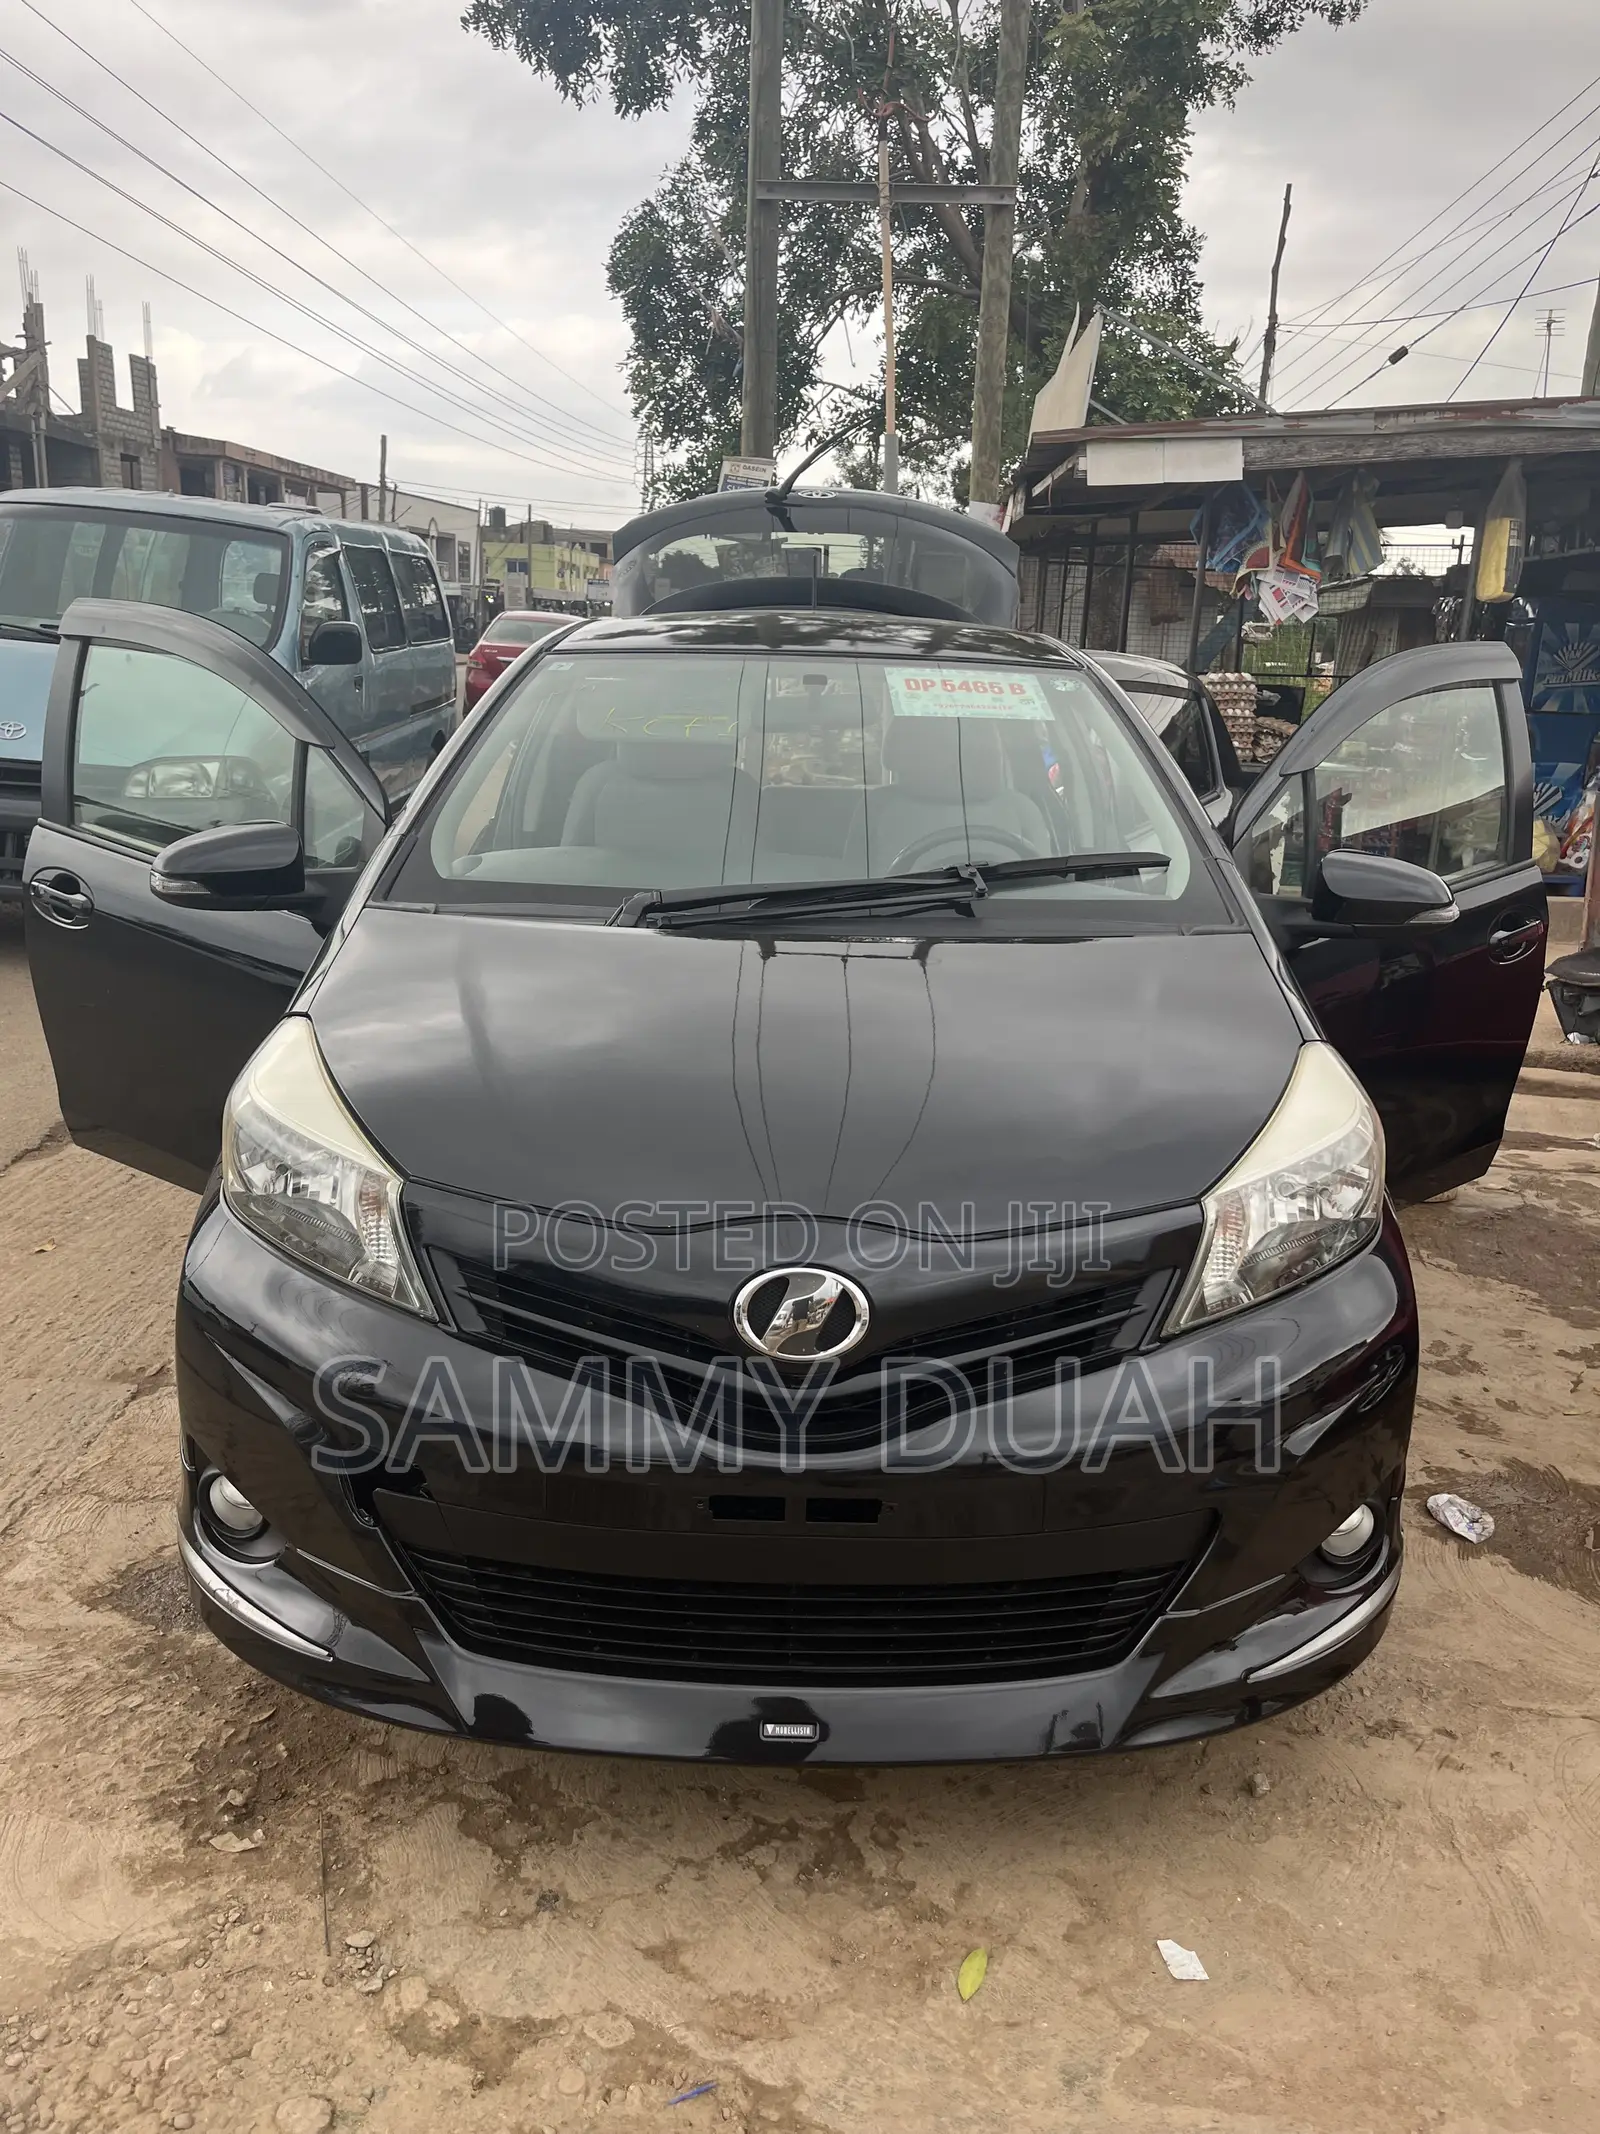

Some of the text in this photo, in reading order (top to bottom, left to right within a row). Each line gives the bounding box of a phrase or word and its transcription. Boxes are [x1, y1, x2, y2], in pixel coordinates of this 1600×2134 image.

[904, 678, 1026, 695] DP 5465 B
